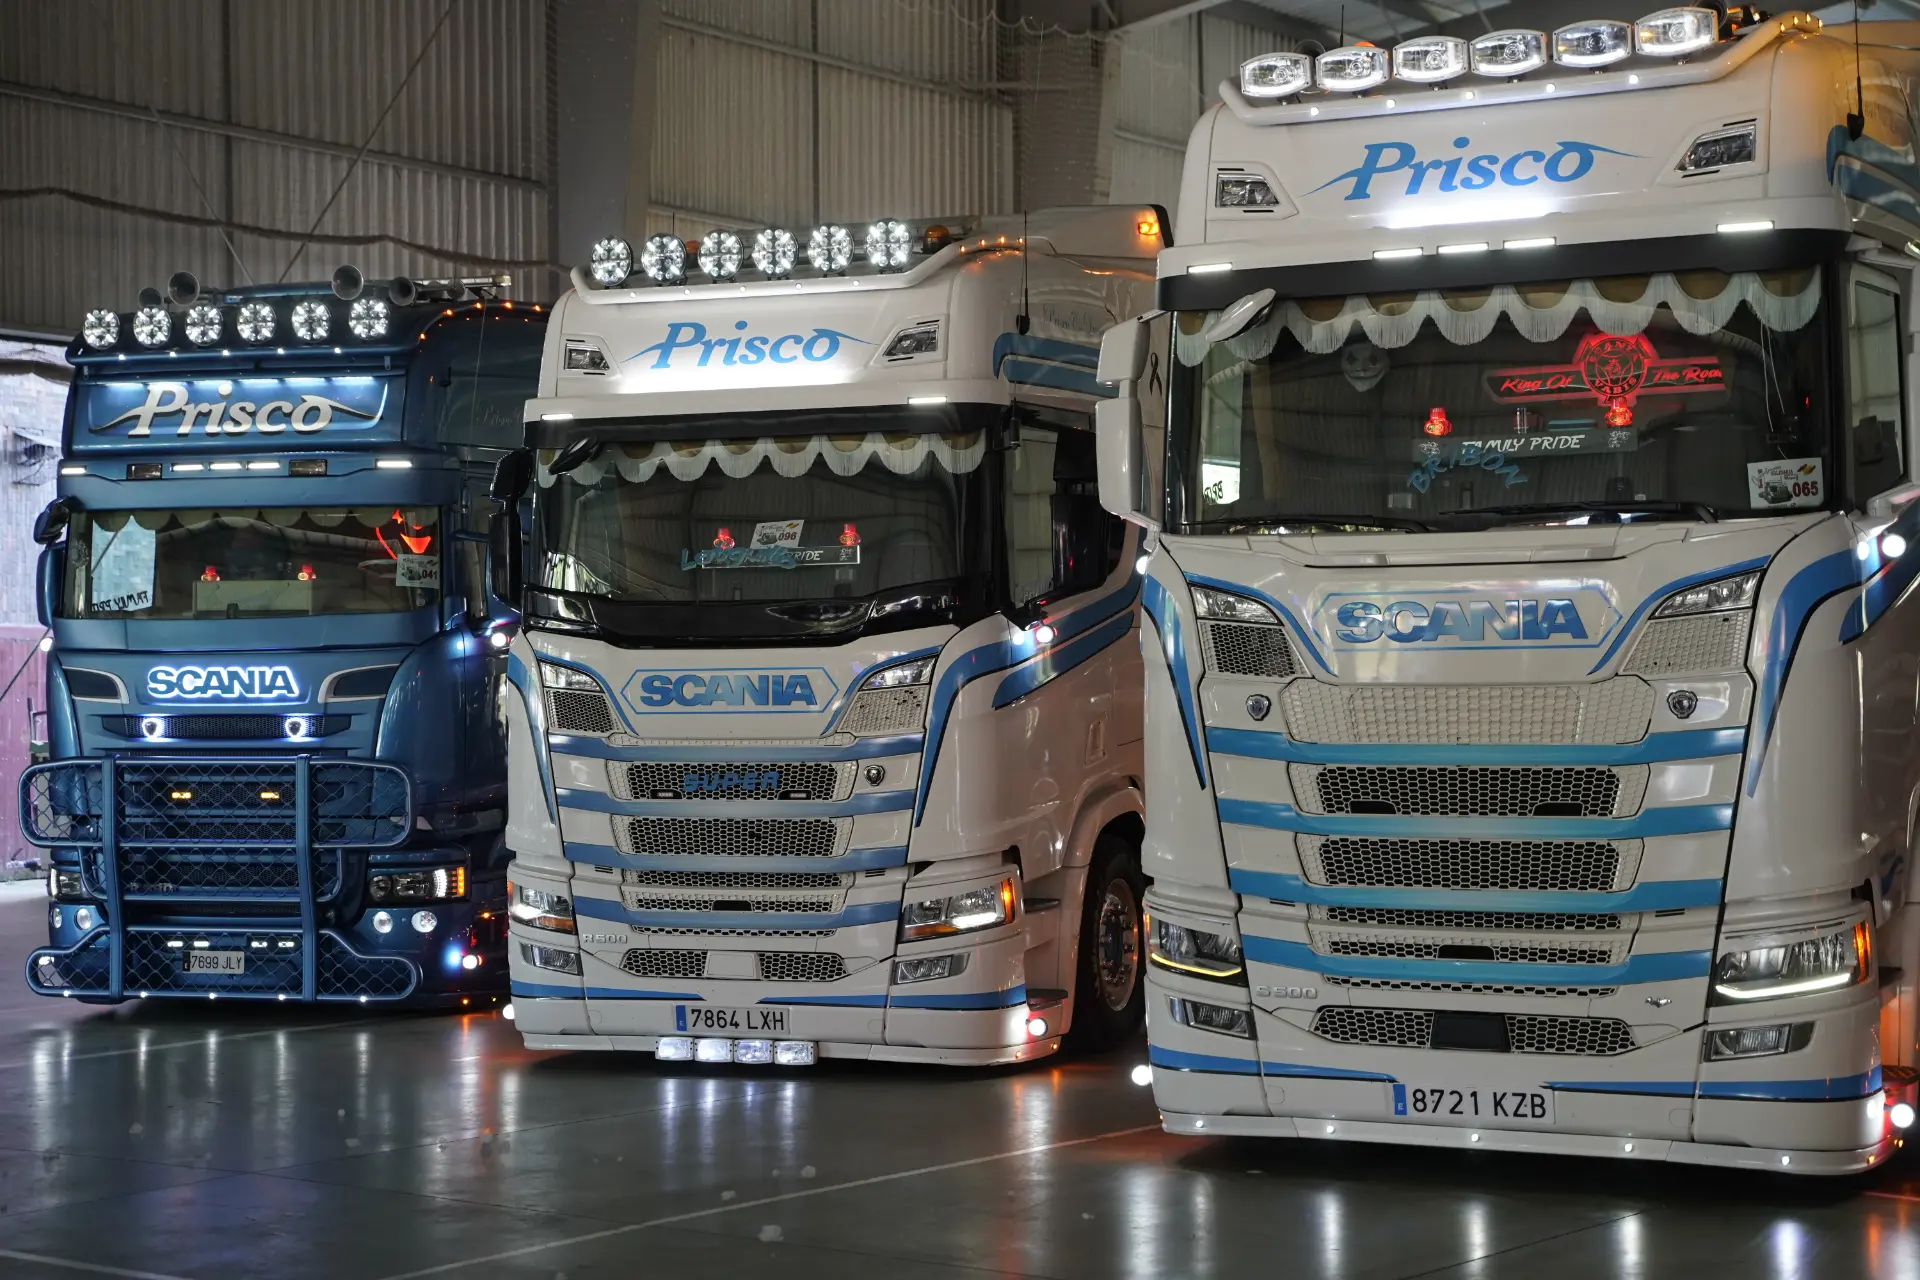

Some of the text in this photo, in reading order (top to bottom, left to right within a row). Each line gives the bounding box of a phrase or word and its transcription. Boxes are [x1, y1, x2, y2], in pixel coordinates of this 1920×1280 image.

[1300, 136, 1652, 201] Prisco
[619, 320, 880, 370] Prisco
[1500, 378, 1542, 393] King
[1652, 368, 1679, 383] The
[88, 383, 384, 438] Prisco
[1530, 434, 1585, 450] PRIDE
[1792, 481, 1819, 498] 065
[778, 532, 797, 541] 096
[422, 569, 438, 580] 041
[1336, 599, 1588, 643] SCANIA
[148, 667, 300, 698] SCANIA
[640, 674, 818, 707] SCANIA
[682, 772, 780, 792] SUPER
[191, 955, 219, 969] 7699
[221, 956, 242, 970] JLY
[691, 1009, 740, 1029] 7864
[747, 1010, 784, 1031] LXH
[1397, 1088, 1547, 1119] E 8721 KZB
